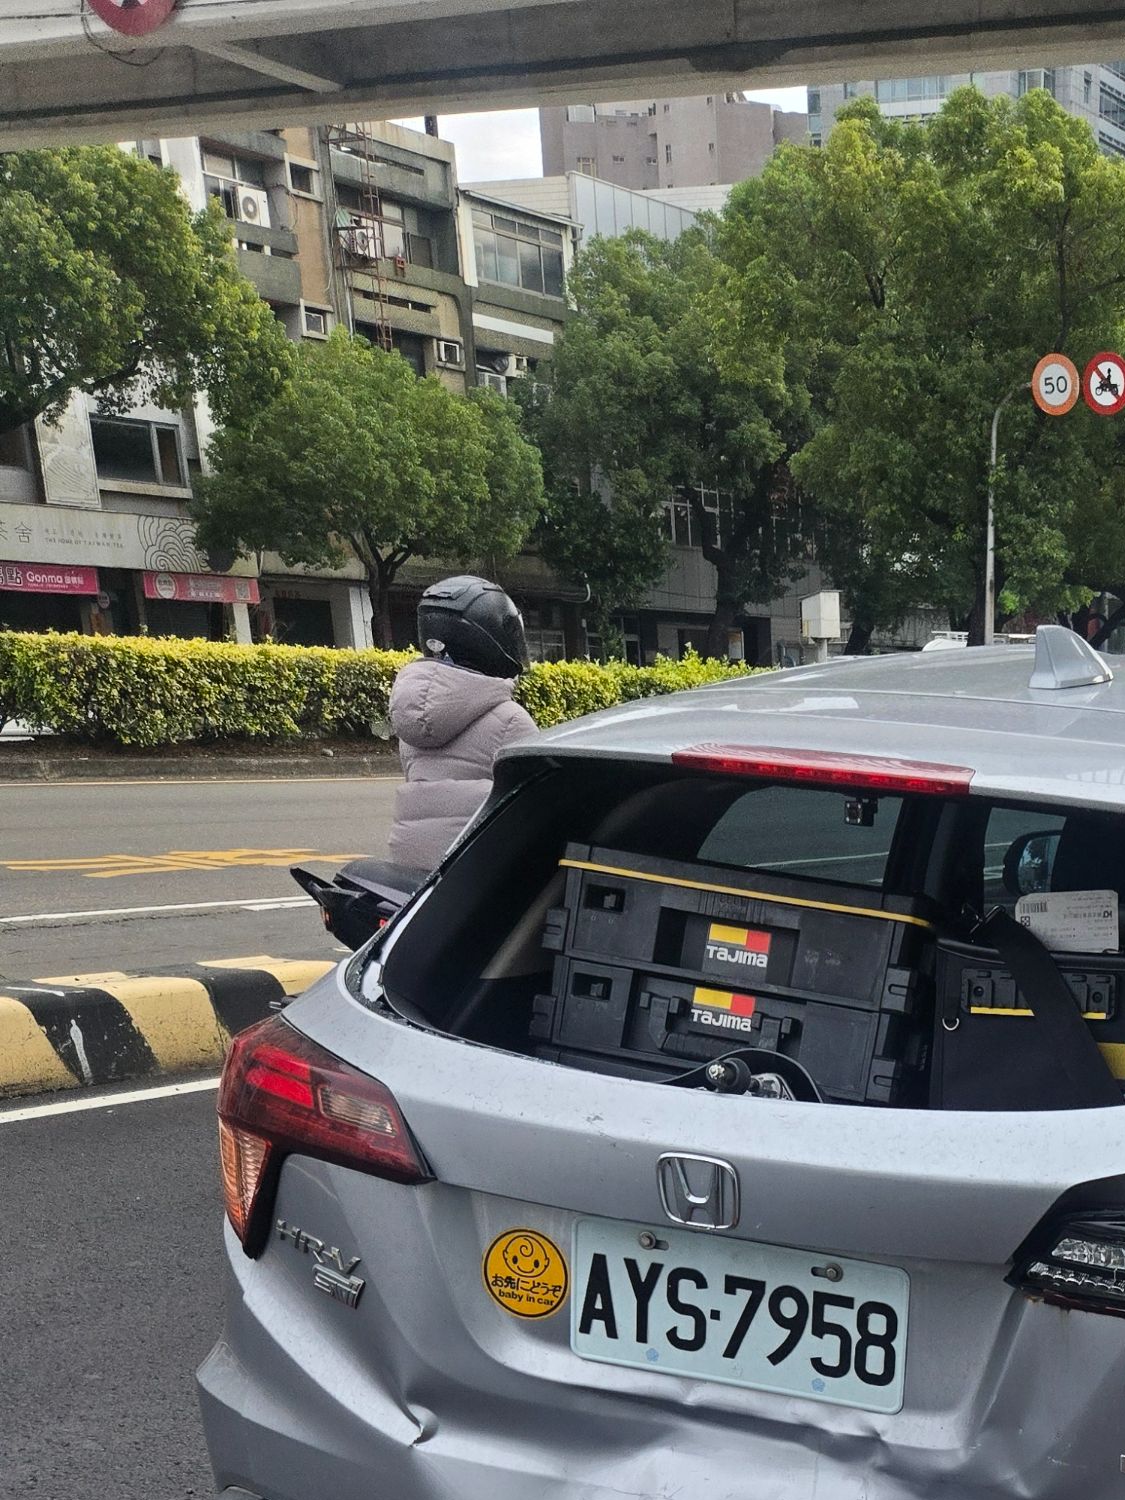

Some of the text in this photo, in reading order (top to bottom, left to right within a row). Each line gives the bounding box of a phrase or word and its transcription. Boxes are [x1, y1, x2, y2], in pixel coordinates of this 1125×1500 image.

[1044, 375, 1068, 394] 50
[26, 571, 64, 584] Gonma
[491, 1273, 562, 1298] お先にどうぞ
[498, 1289, 555, 1307] baby in car
